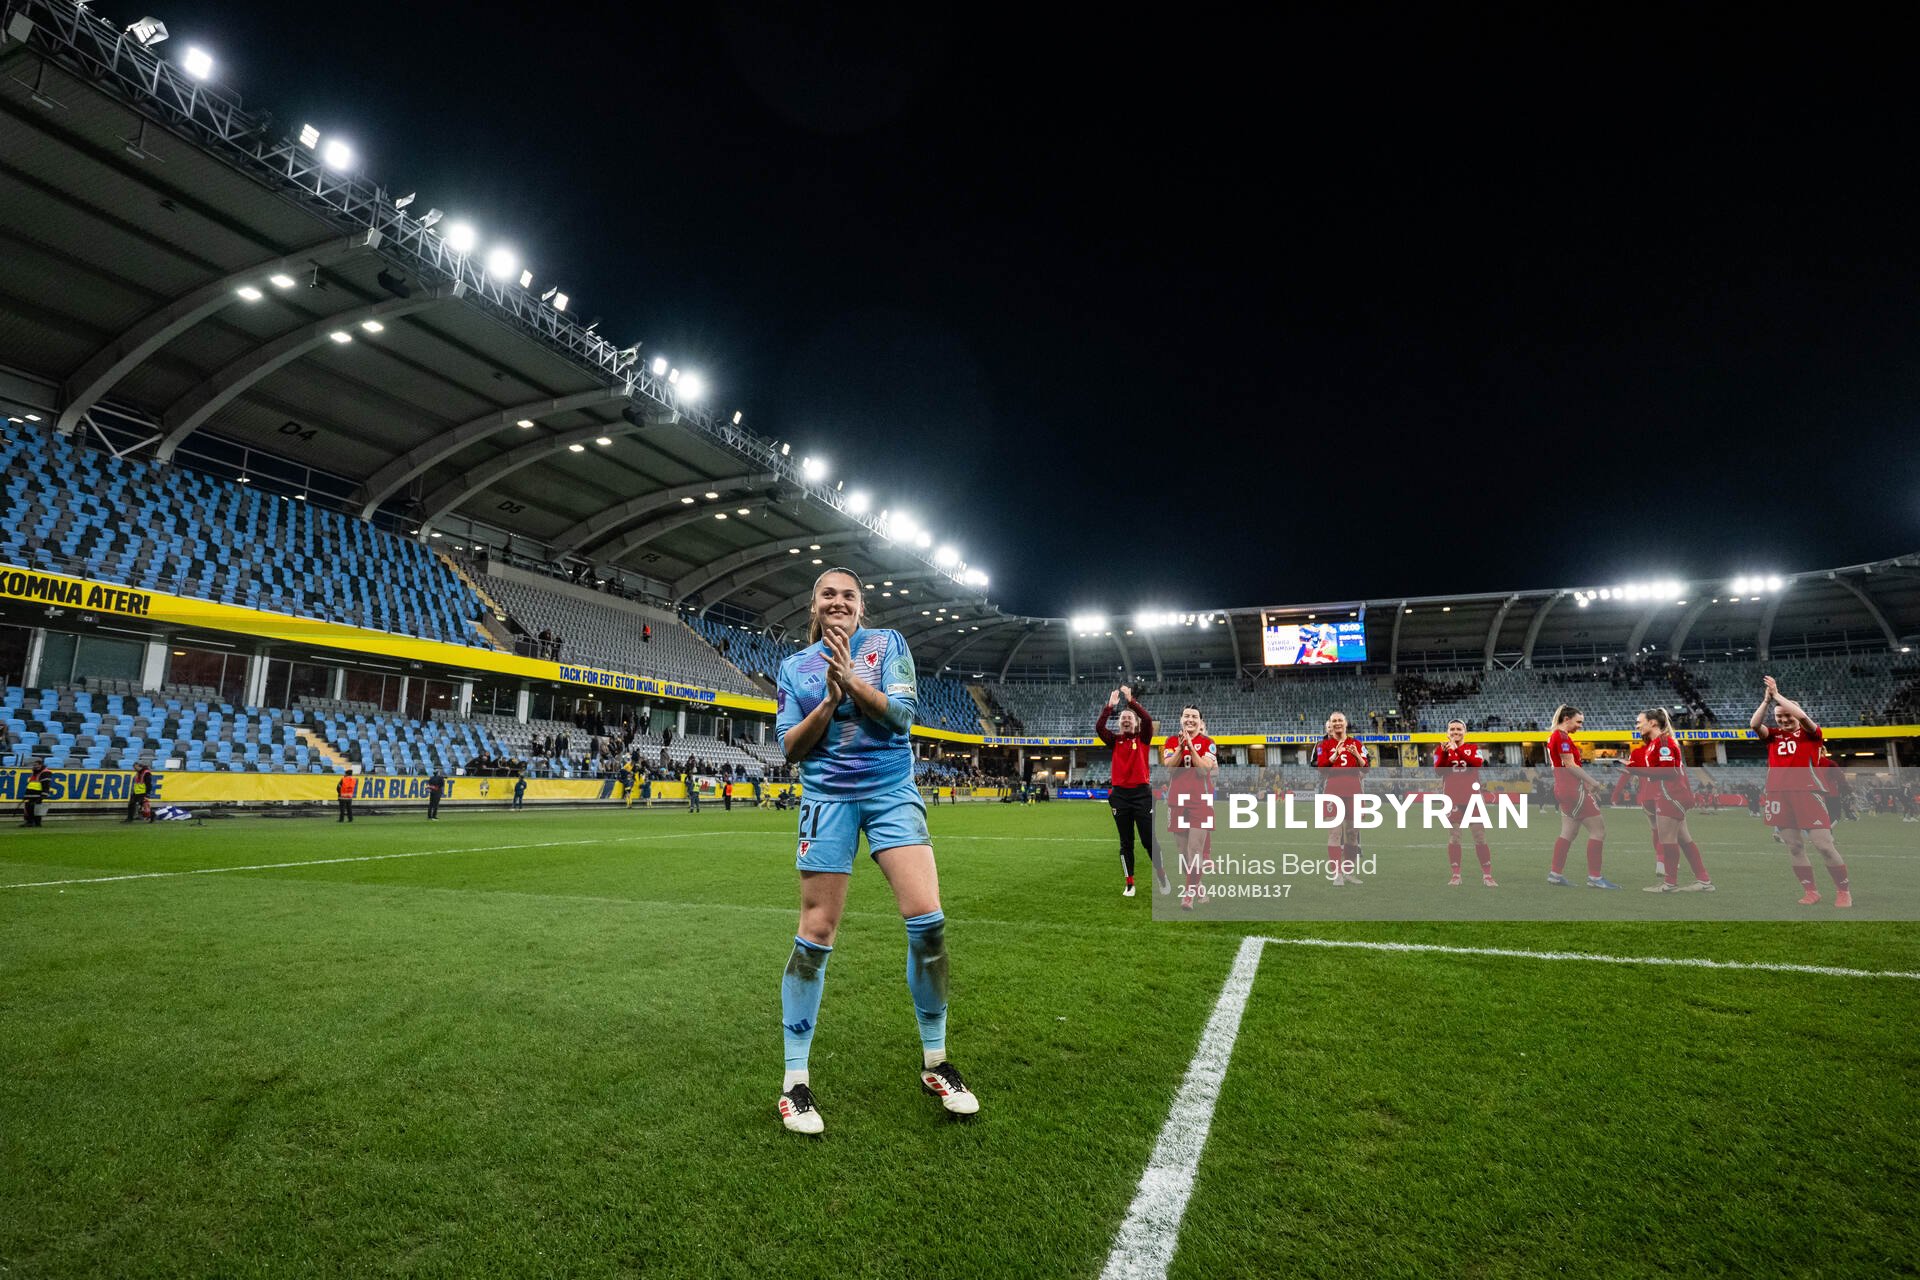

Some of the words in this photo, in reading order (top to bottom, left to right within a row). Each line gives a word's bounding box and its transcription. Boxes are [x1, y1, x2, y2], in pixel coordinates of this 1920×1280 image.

[560, 666, 581, 681] TACK
[600, 673, 614, 687] ERT
[1777, 741, 1797, 755] 20
[1184, 755, 1191, 768] 8
[1341, 754, 1347, 766] 5
[1451, 760, 1467, 772] 23
[799, 804, 821, 838] 21
